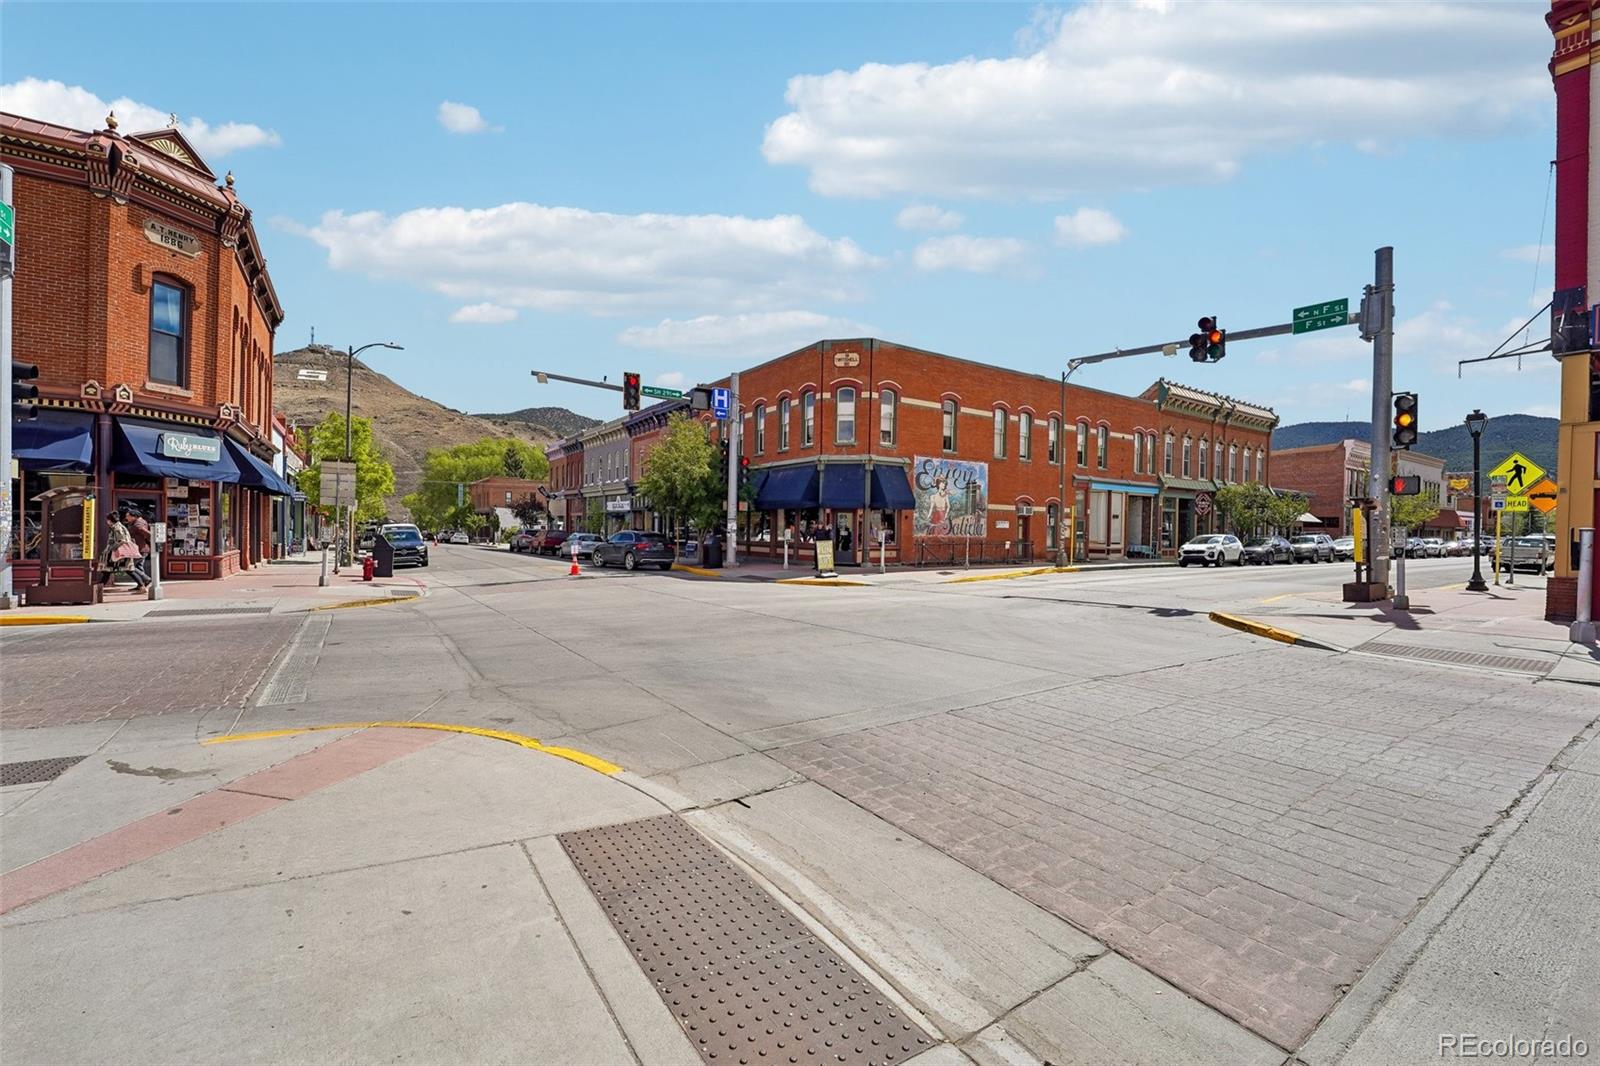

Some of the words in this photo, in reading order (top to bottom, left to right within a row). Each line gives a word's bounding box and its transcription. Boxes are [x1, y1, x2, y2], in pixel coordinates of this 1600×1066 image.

[160, 234, 184, 249] 1886
[168, 229, 195, 245] HENRY
[1313, 308, 1319, 316] N
[1323, 305, 1330, 314] F
[1334, 304, 1344, 312] St
[1305, 320, 1313, 329] F
[714, 389, 728, 408] H
[167, 437, 192, 456] Ruby
[916, 459, 975, 490] Enjoy
[943, 515, 984, 536] Salida
